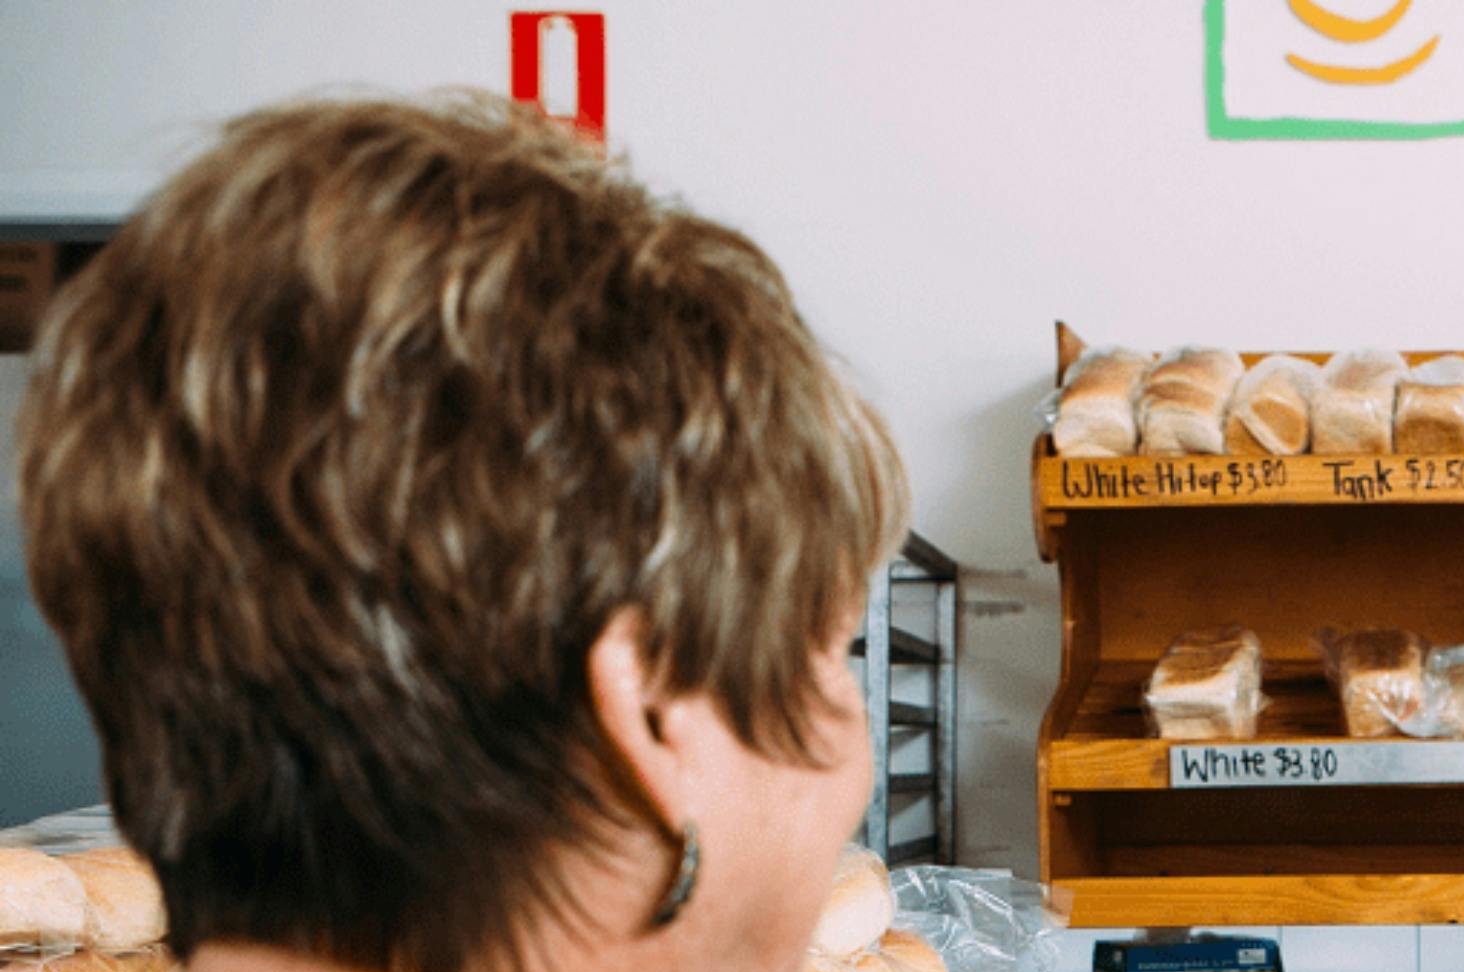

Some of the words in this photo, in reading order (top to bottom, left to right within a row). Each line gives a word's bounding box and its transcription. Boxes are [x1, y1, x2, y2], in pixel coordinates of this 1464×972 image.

[1062, 460, 1149, 498] White
[1322, 459, 1393, 500] Tank
[1181, 747, 1266, 783] White
